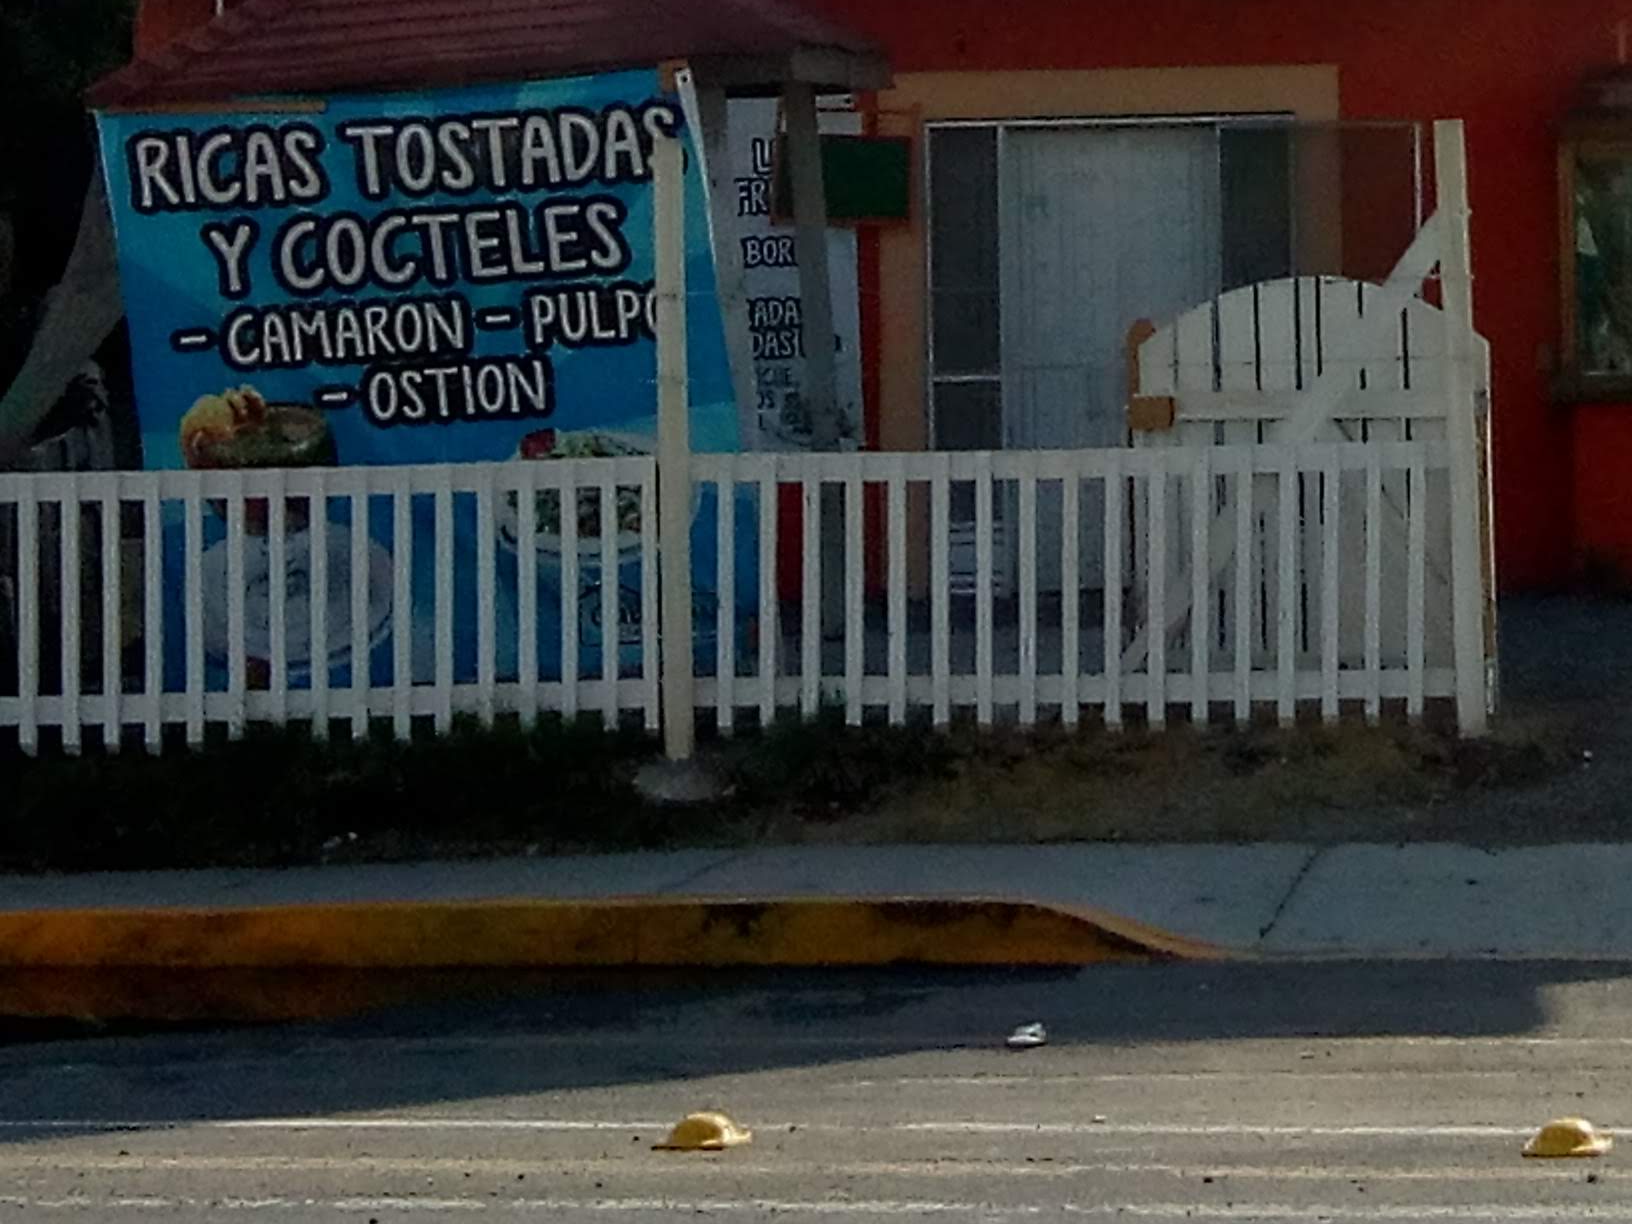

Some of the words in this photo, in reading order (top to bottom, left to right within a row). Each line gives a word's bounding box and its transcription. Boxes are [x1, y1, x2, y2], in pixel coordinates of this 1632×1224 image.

[134, 129, 323, 210] RICAS
[342, 104, 677, 196] TOSTADAS
[207, 222, 253, 293] Y
[278, 200, 626, 290] COCTELES
[225, 303, 466, 365] CAMARON
[366, 359, 549, 421] OSTION
